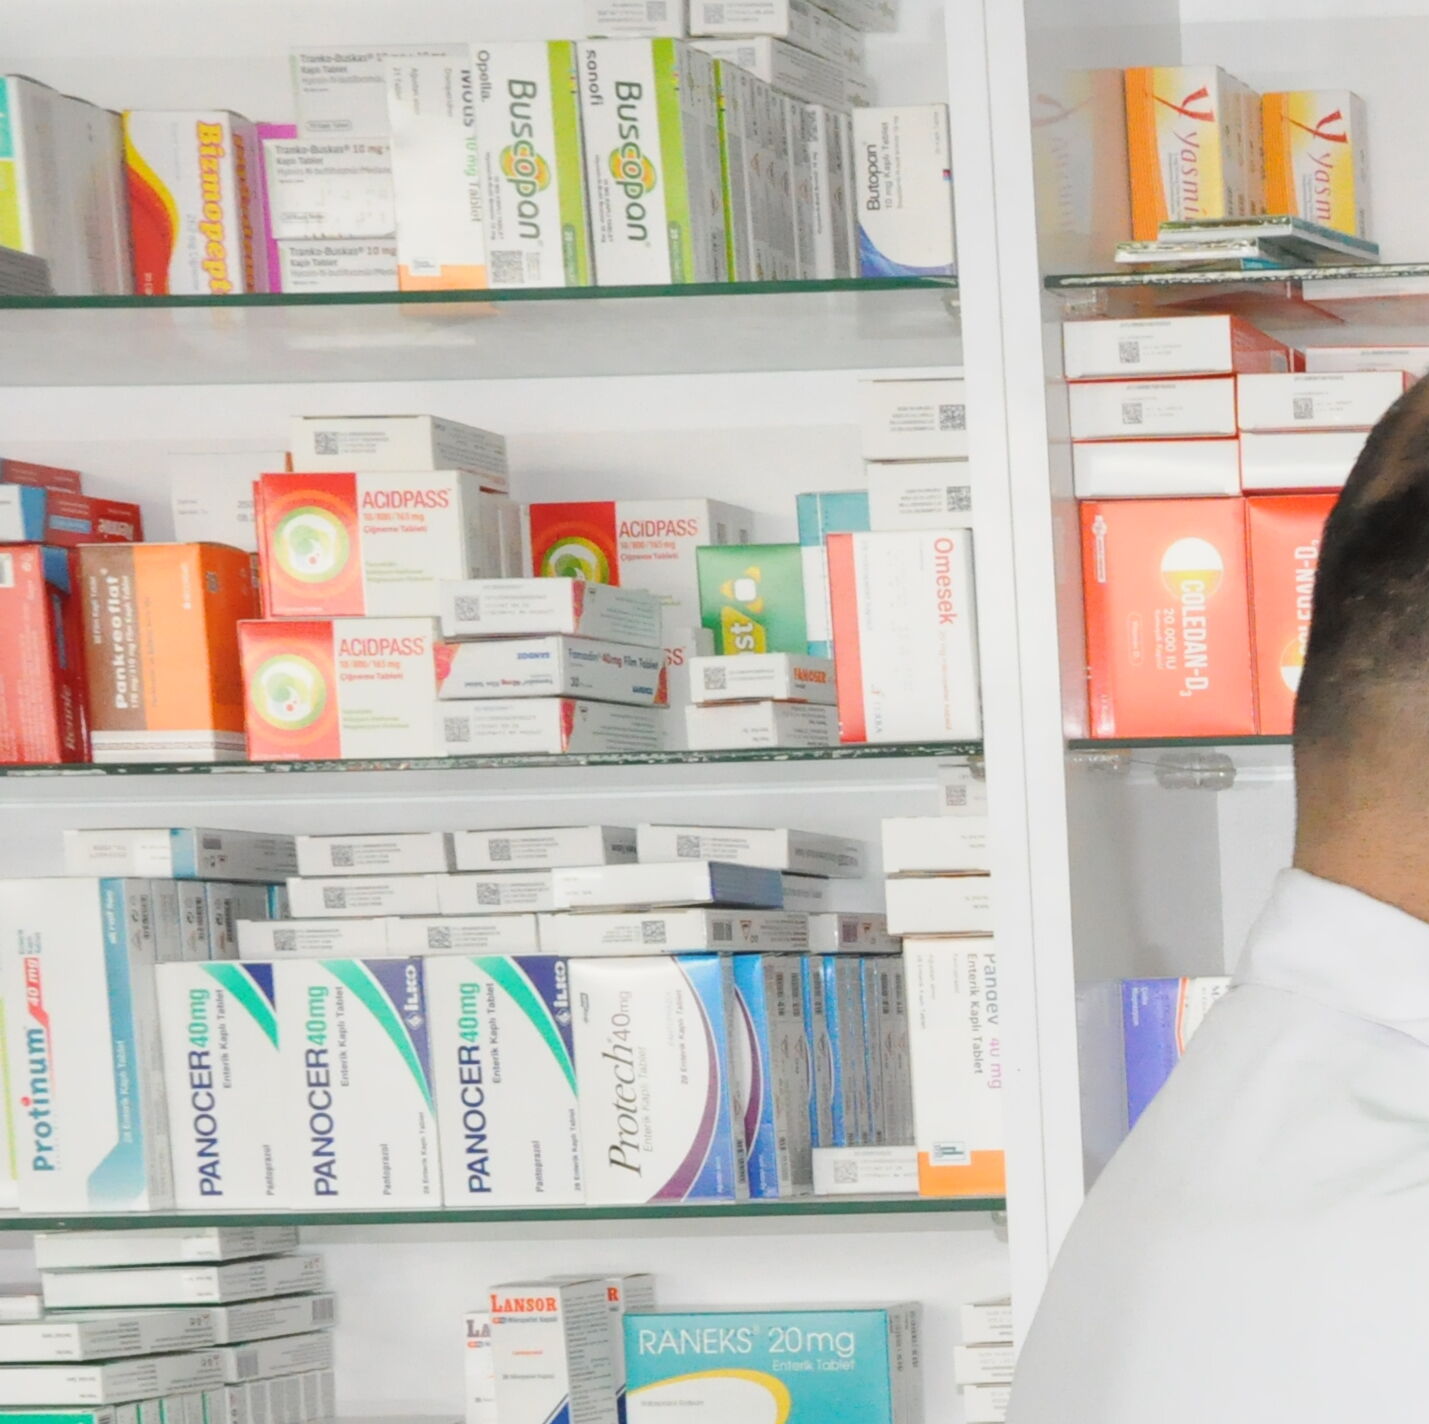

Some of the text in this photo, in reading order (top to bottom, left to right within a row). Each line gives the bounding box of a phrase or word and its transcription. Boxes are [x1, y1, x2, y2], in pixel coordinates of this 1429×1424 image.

[587, 50, 604, 106] sanofi
[195, 120, 234, 294] Bizmopept
[507, 79, 540, 240] Buscopan
[614, 80, 648, 243] Buscopan
[865, 143, 881, 212] Butopan
[105, 575, 127, 709] pankreoflat
[933, 537, 956, 625] Omesek
[22, 1027, 55, 1172] Protinum
[188, 988, 223, 1196] PANOCER 40mg
[222, 1047, 232, 1088] Enterik
[305, 985, 340, 1196] PANOCER 40mg
[457, 982, 492, 1194] PANOCER 40mg
[602, 1042, 643, 1178] Protech
[490, 1293, 558, 1313] LANSOR
[638, 1327, 856, 1357] RANEKS 20mg
[772, 1359, 856, 1371] Enterik Tablet
